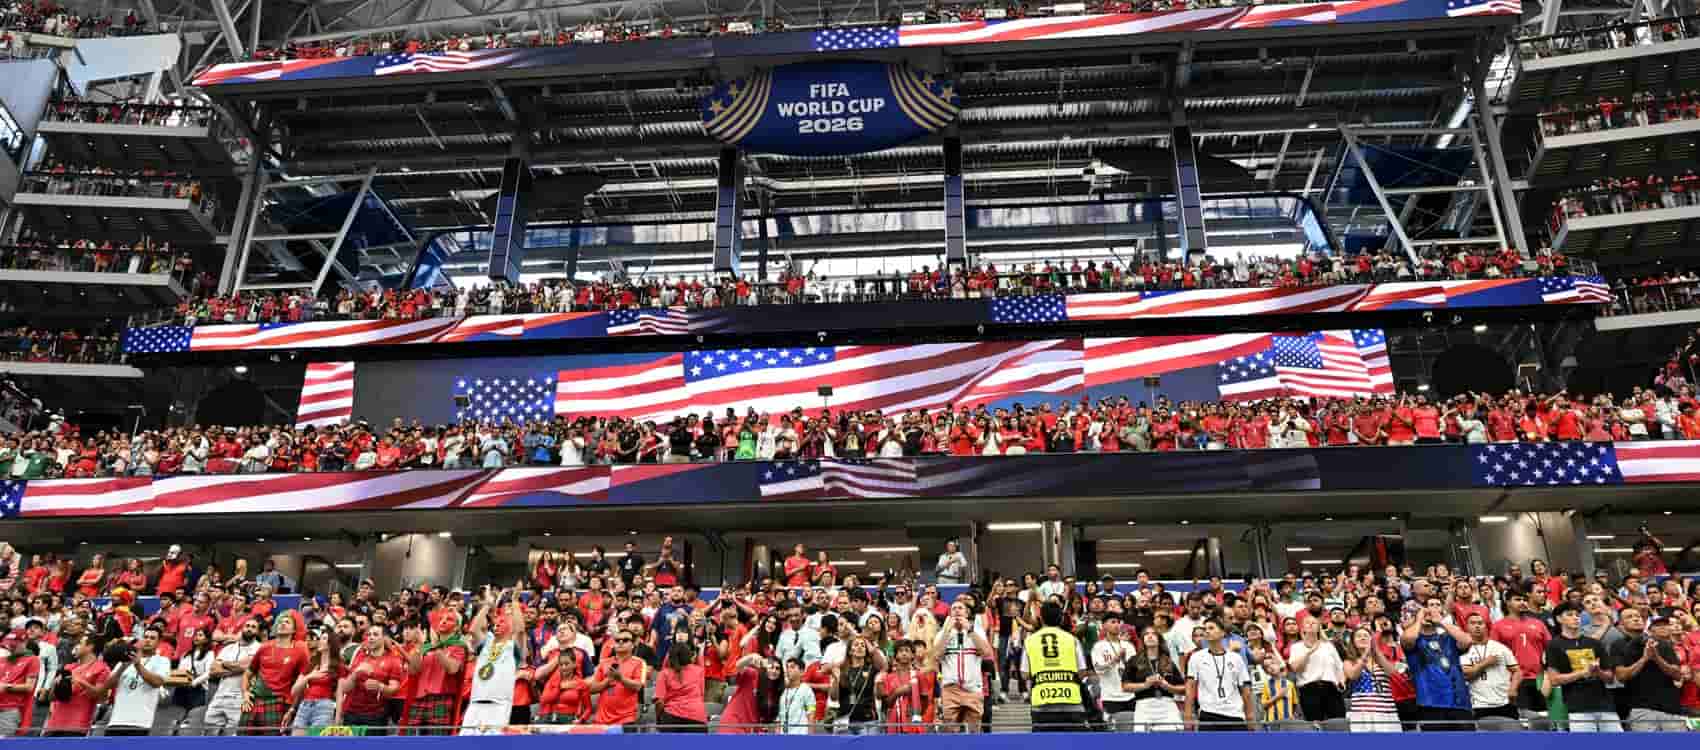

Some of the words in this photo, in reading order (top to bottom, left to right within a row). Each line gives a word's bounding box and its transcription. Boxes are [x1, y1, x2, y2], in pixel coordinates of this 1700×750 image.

[809, 82, 850, 98] FIFA
[777, 100, 845, 117] WORLD
[848, 97, 885, 113] CUP
[799, 116, 864, 133] 2026
[1036, 672, 1073, 682] SECURITY
